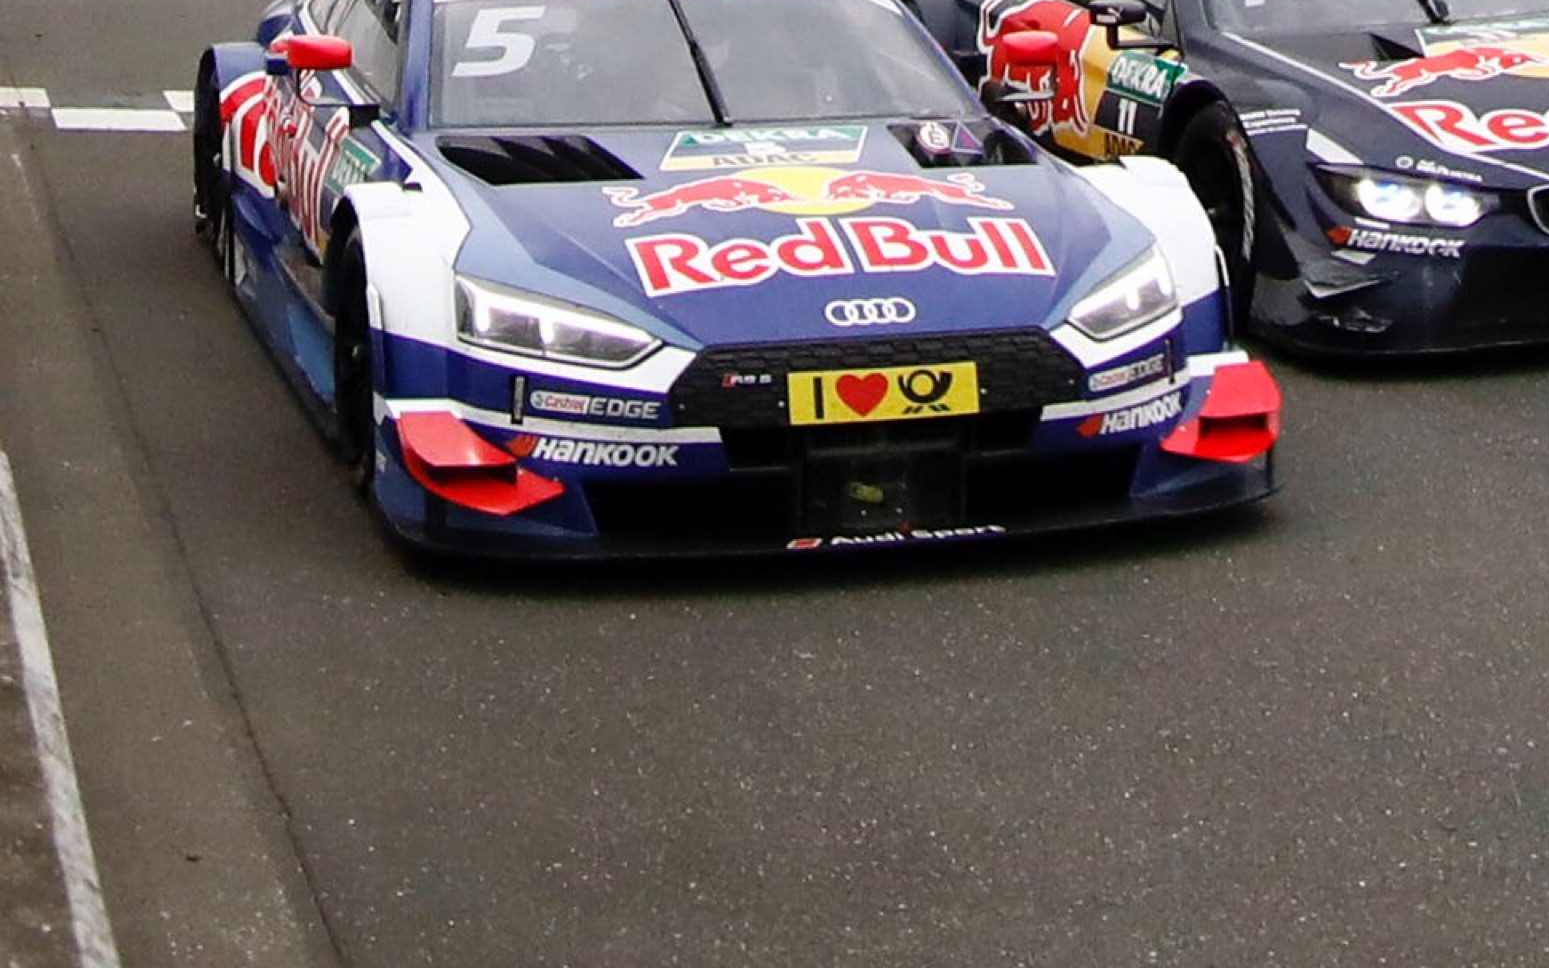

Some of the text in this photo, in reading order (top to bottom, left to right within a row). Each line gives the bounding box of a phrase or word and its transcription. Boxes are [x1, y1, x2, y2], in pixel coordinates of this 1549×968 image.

[452, 7, 545, 78] 5
[634, 220, 1047, 291] Red Bull
[588, 397, 662, 420] EDGE
[814, 377, 824, 419] I
